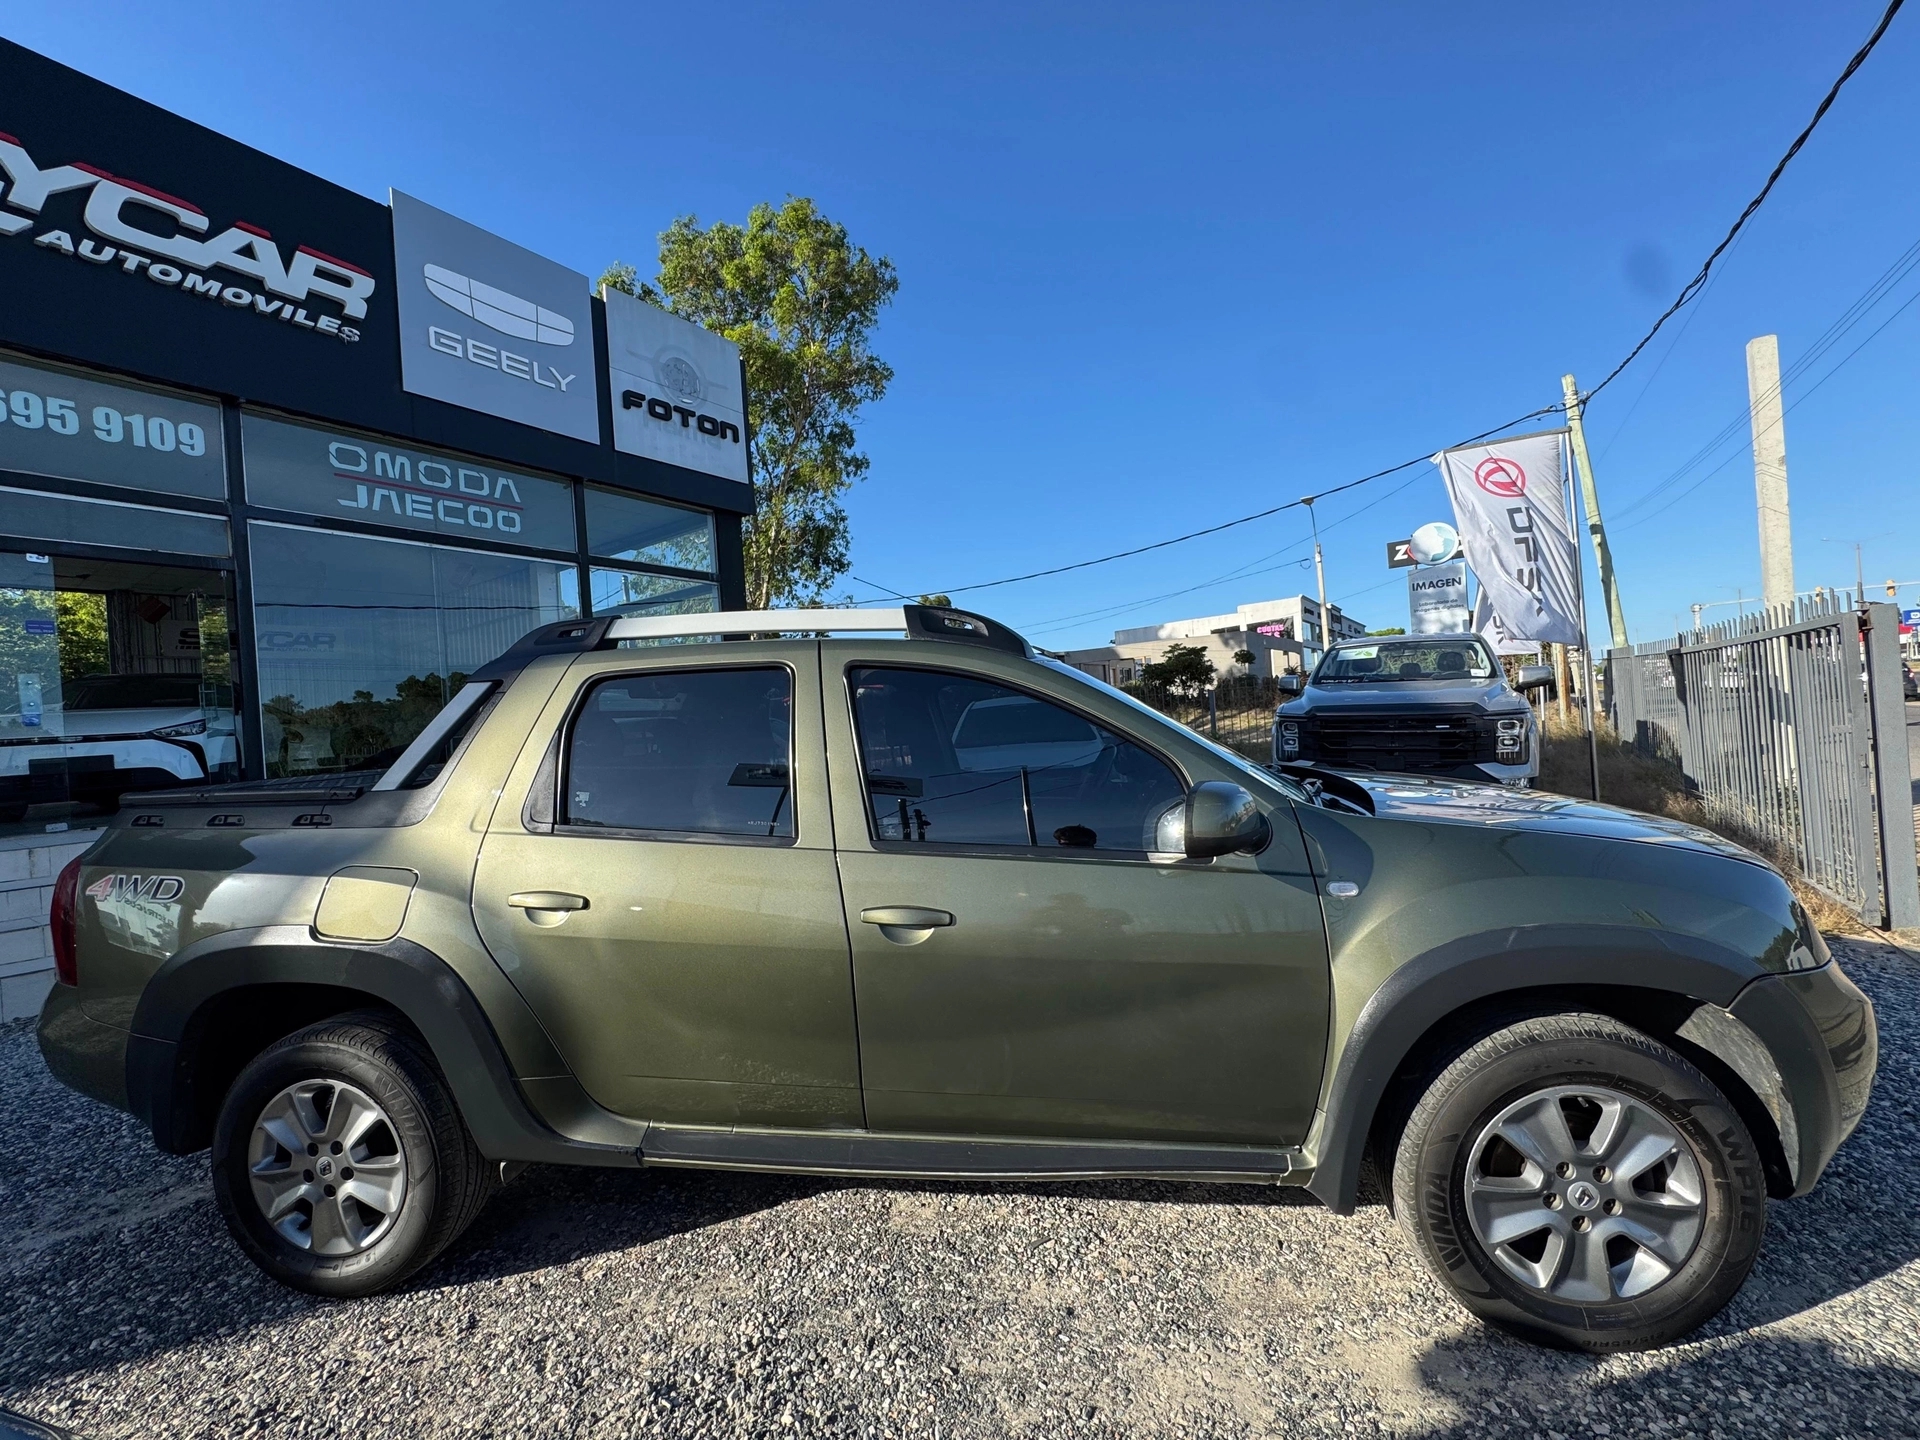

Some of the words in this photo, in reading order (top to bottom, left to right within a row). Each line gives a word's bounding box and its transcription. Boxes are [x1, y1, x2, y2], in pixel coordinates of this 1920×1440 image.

[0, 131, 375, 322] YCAR
[34, 229, 361, 343] AUTOMOVILES
[428, 325, 576, 392] GEELY
[0, 388, 80, 436] 95
[92, 406, 206, 457] 9109
[622, 389, 740, 444] FOTON
[328, 441, 521, 503] OMODA
[337, 484, 522, 533] JAECOO
[1412, 577, 1462, 592] IMAGEN
[85, 874, 185, 903] 4WD
